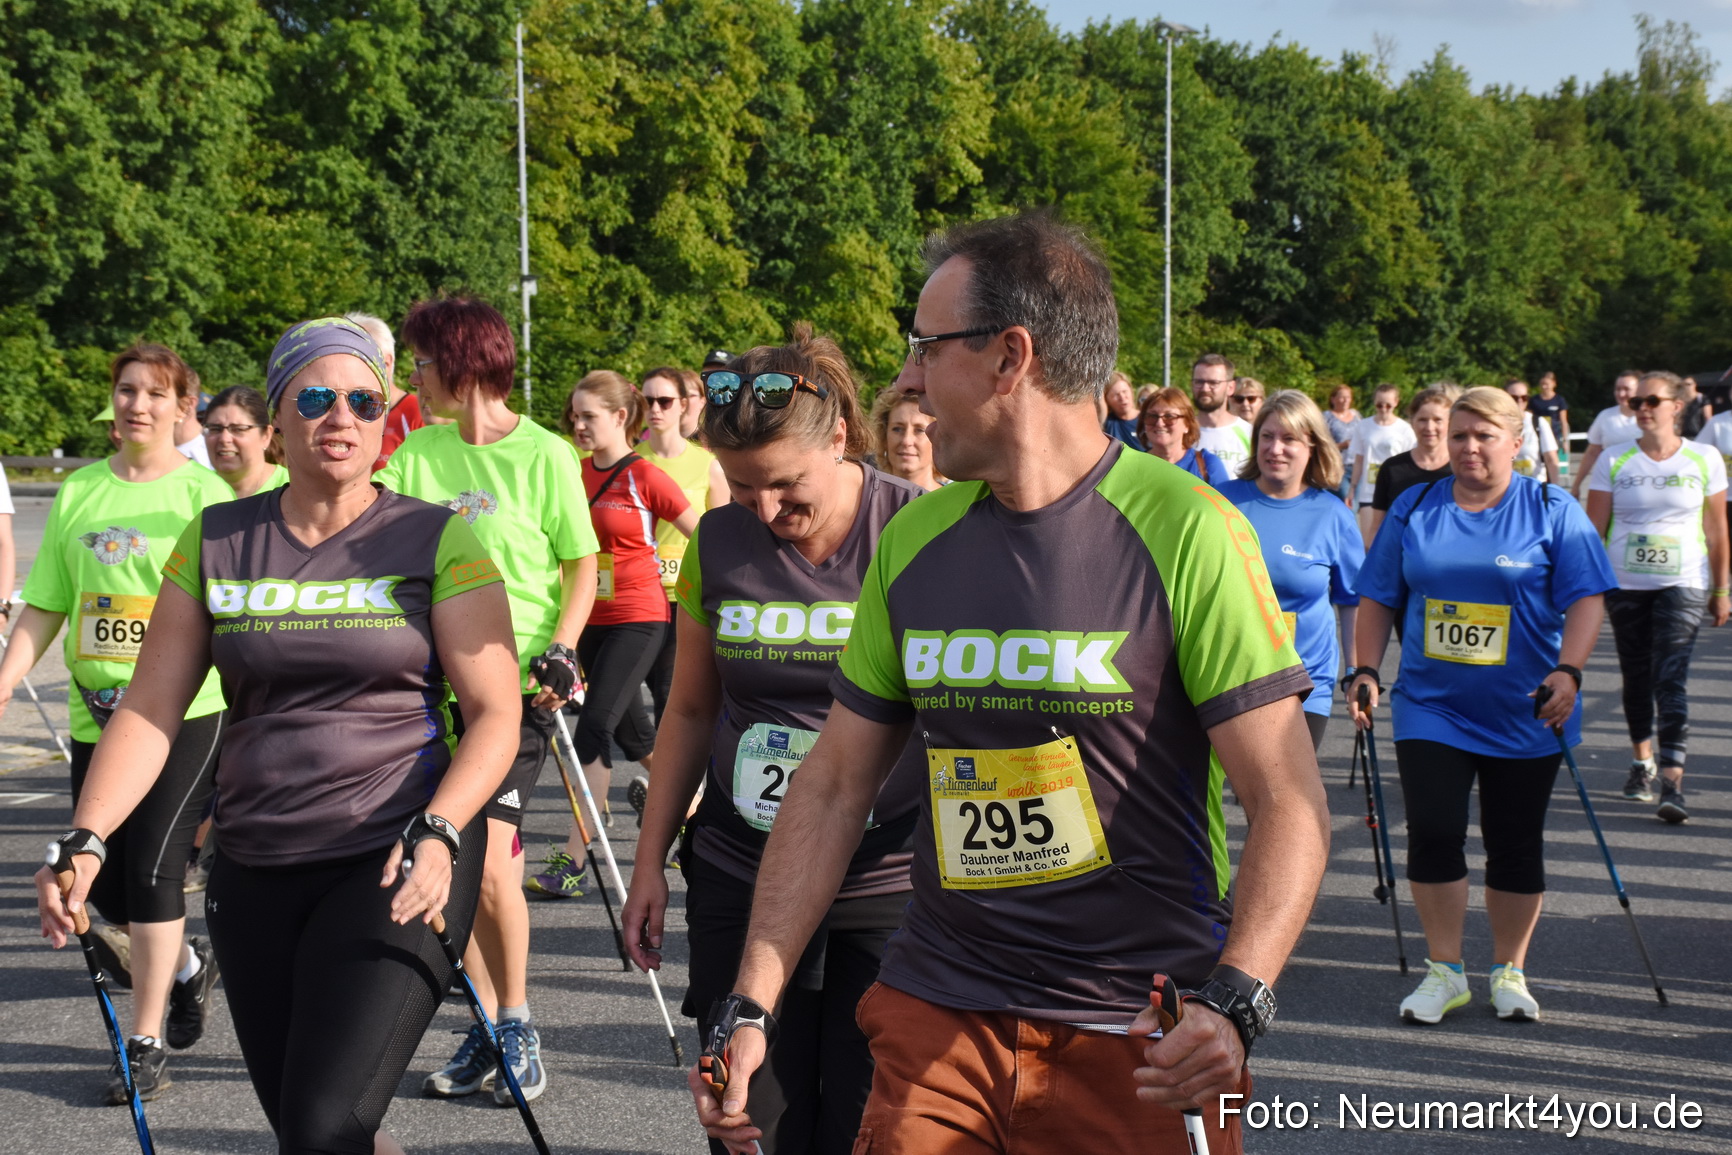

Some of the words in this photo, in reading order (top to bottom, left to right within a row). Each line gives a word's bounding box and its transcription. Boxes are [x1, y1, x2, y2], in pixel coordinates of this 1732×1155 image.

[1636, 548, 1668, 564] 923
[450, 559, 502, 586] BO
[208, 578, 396, 615] BOCK
[95, 618, 146, 643] 669
[254, 620, 274, 634] by
[278, 617, 329, 630] smart
[333, 615, 407, 631] concepts
[719, 605, 855, 640] BOC
[1435, 622, 1497, 648] 1067
[715, 642, 763, 660] inspired
[768, 648, 788, 663] by
[793, 650, 841, 661] smart
[904, 637, 1118, 685] BOCK
[955, 690, 976, 712] by
[981, 695, 1034, 711] smart
[1039, 698, 1134, 717] concepts
[759, 764, 799, 802] 2
[947, 777, 998, 792] firmenlauf
[1007, 781, 1038, 797] walk
[1040, 776, 1074, 794] 2019
[497, 797, 521, 809] adidas
[754, 801, 779, 812] Micha
[757, 812, 774, 822] Bock
[959, 798, 1054, 850] 295
[960, 852, 1010, 865] Daubner
[1013, 843, 1071, 863] Manfred
[965, 867, 986, 876] Bock
[987, 867, 993, 876] 1
[994, 865, 1023, 875] GmbH
[1024, 863, 1032, 872] &
[1033, 862, 1051, 871] Co.
[1052, 857, 1068, 867] KG
[1236, 1002, 1256, 1039] EKI
